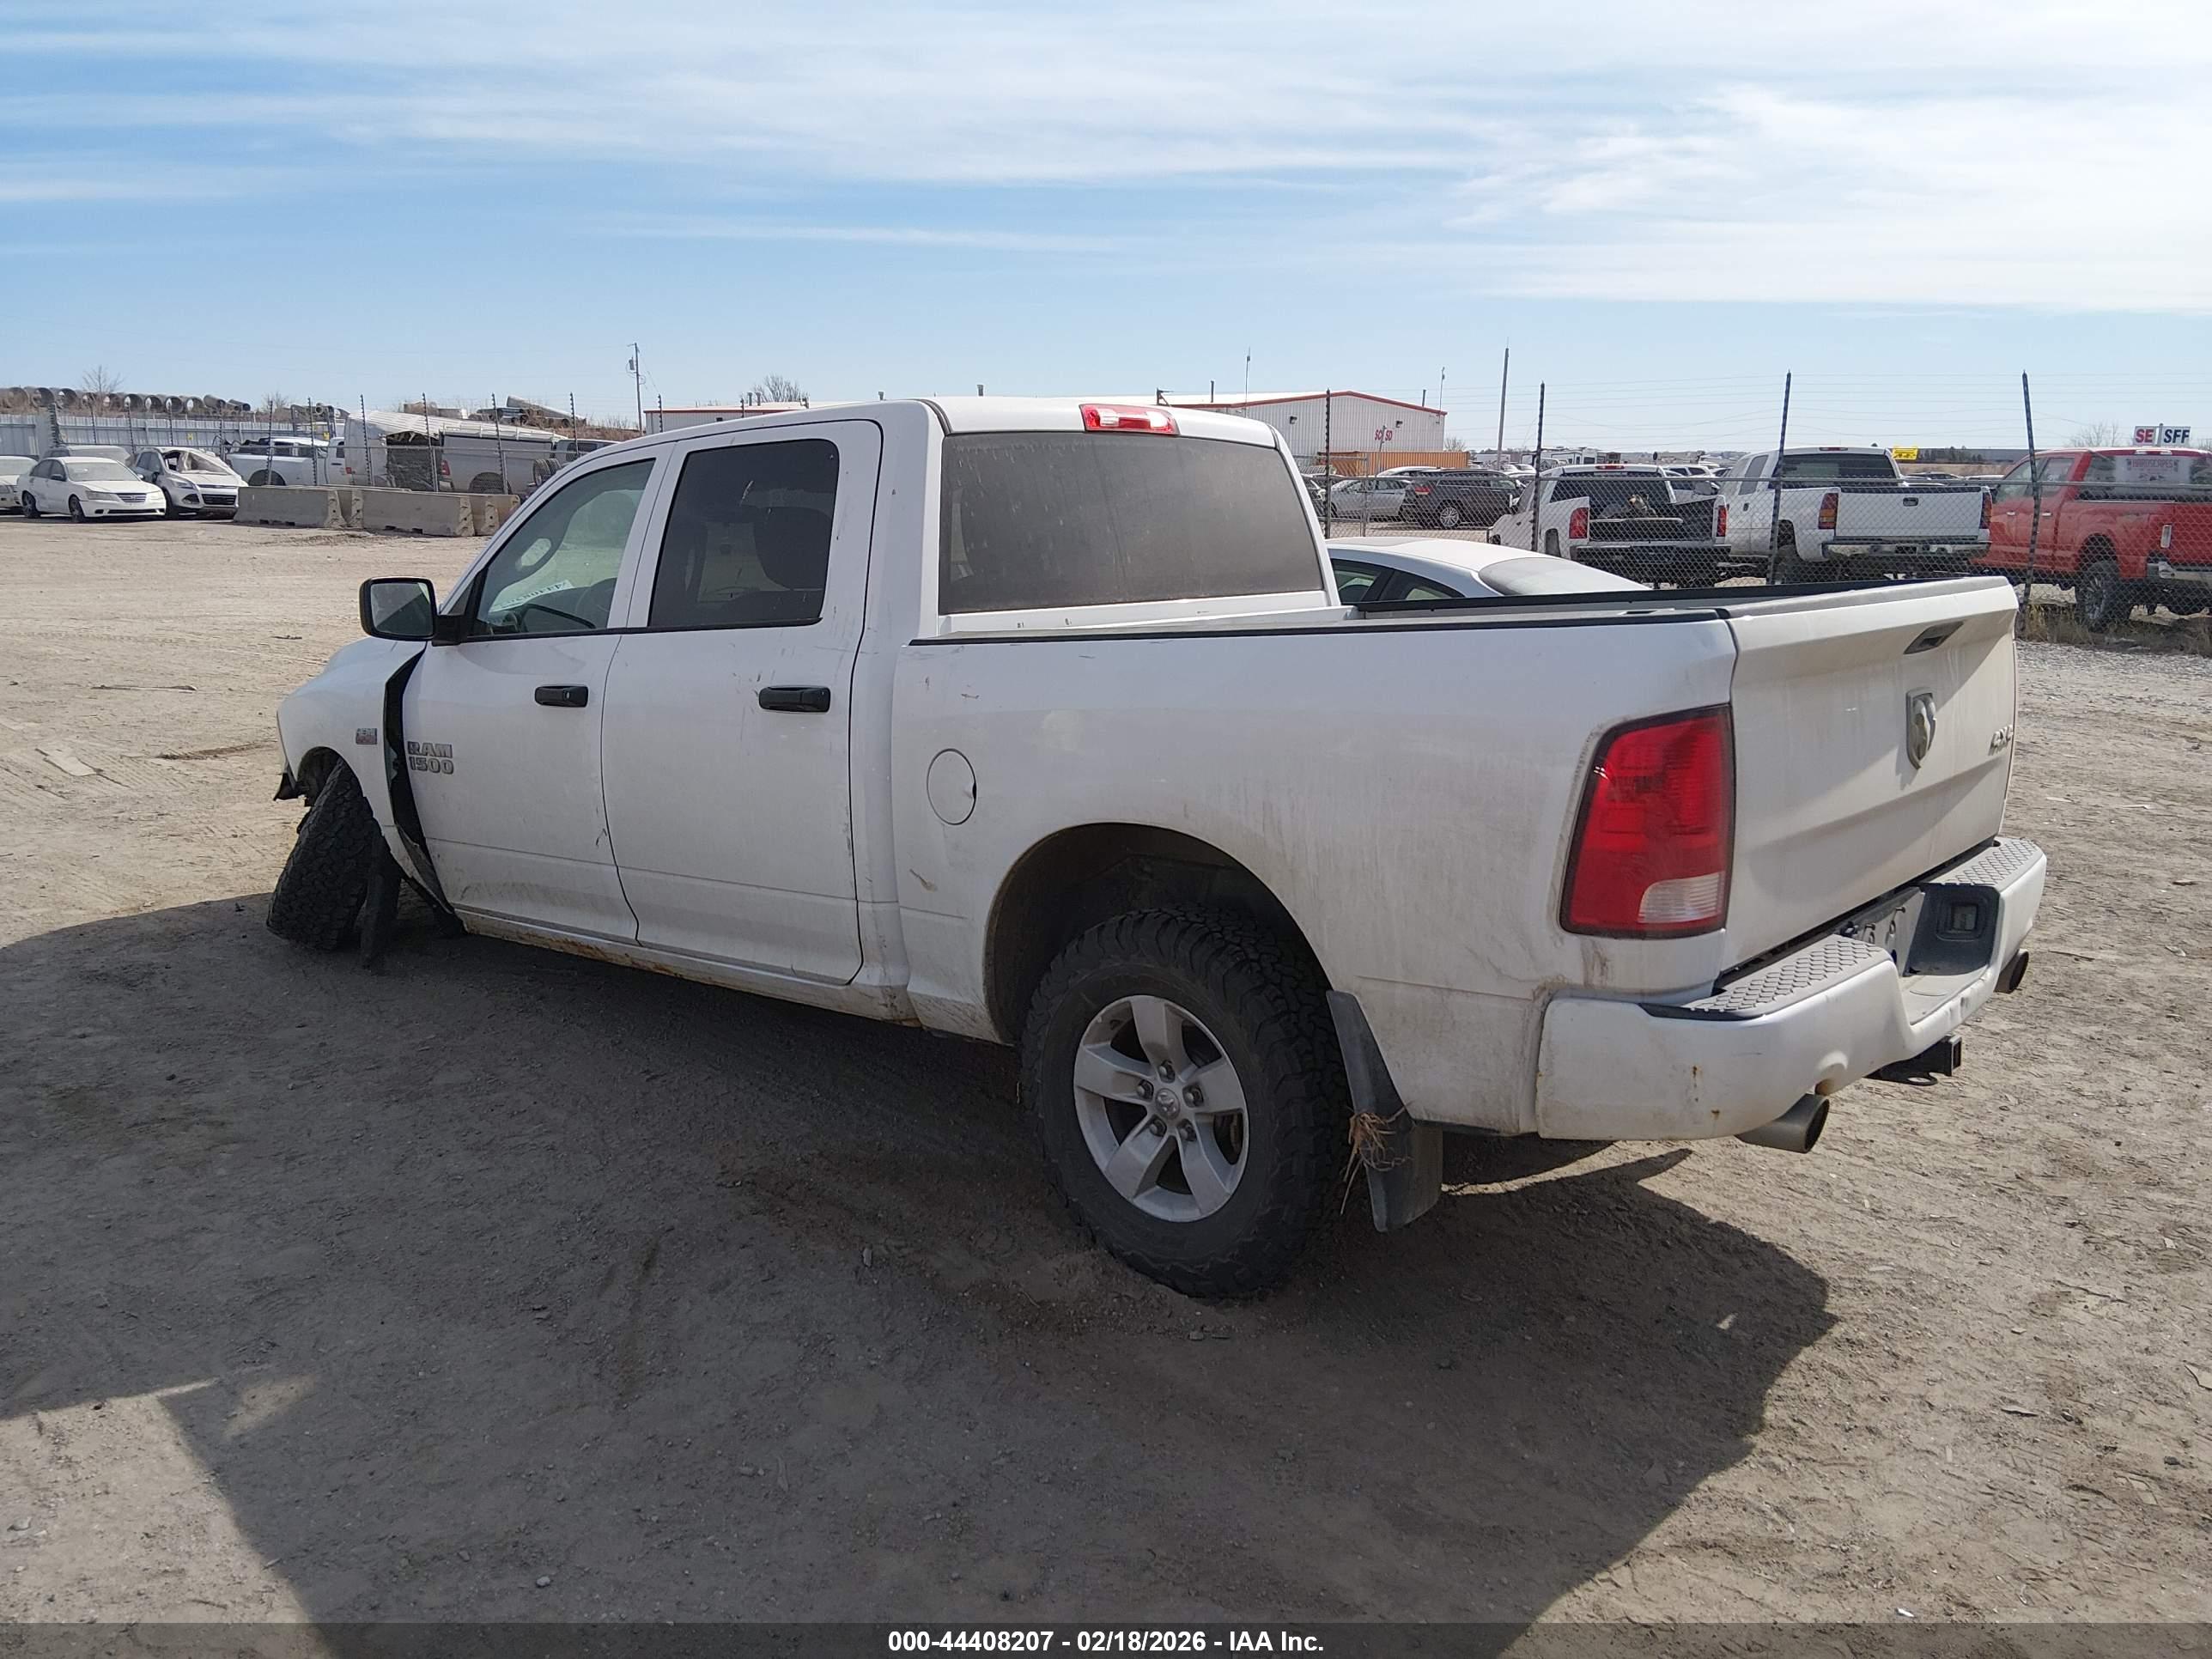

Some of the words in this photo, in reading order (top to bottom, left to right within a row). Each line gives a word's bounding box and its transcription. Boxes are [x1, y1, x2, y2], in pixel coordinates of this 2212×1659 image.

[2135, 428, 2154, 444] SE
[2163, 428, 2191, 444] SFF
[407, 740, 453, 758] RAM
[409, 756, 454, 775] 1500
